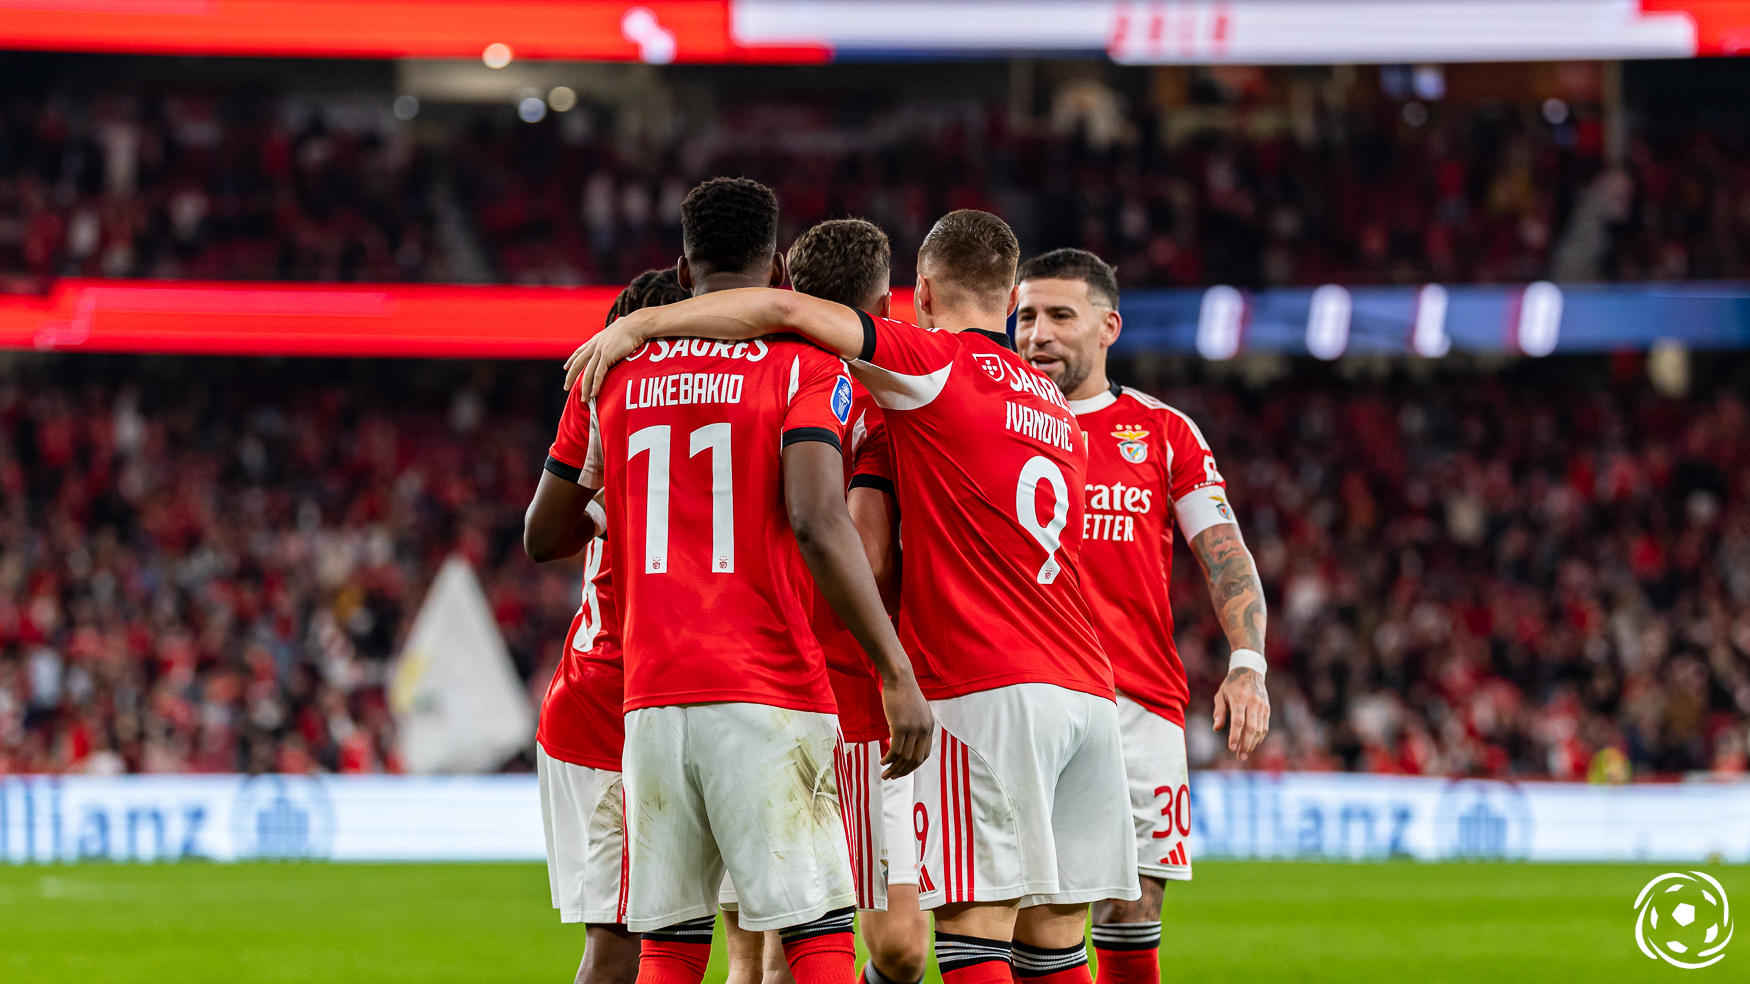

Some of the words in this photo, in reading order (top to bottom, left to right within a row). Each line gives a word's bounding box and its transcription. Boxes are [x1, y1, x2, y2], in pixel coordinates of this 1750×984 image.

[625, 372, 744, 410] LUKEBAKIO
[1005, 400, 1073, 453] IVANOVIĆ
[627, 422, 735, 575] 11
[1015, 455, 1070, 585] 9
[1082, 513, 1134, 542] ETTER
[0, 778, 207, 859] llianz
[913, 801, 930, 863] 9
[1152, 783, 1192, 839] 30
